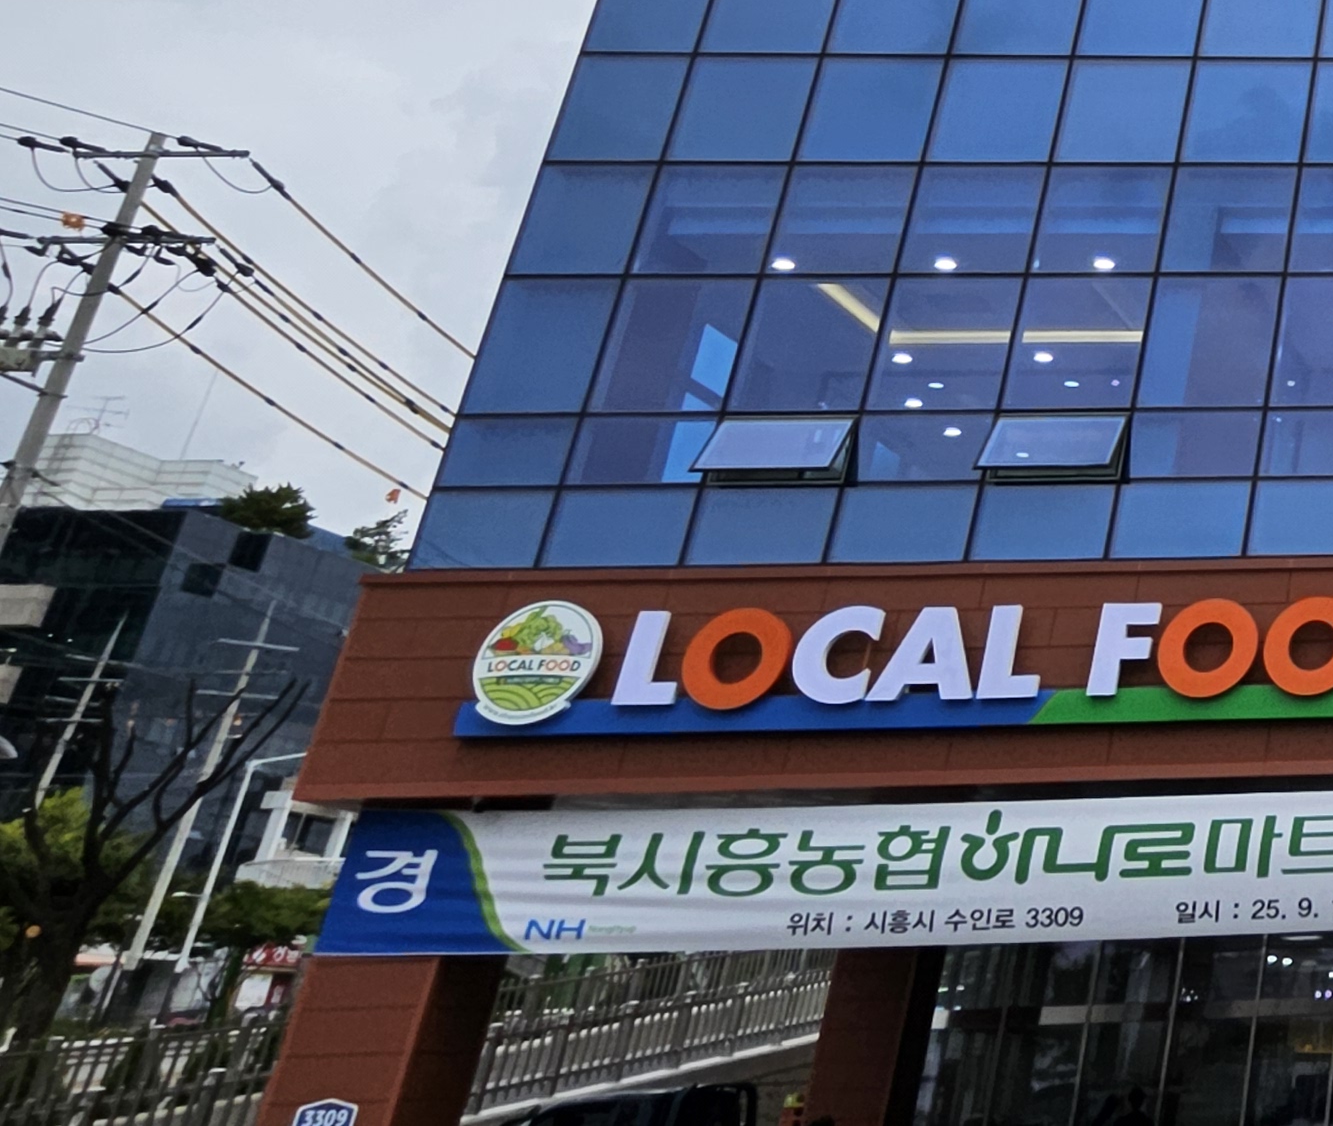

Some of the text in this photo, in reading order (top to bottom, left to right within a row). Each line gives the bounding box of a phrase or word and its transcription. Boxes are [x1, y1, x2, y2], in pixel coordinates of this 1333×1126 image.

[487, 659, 581, 673] LOCAL FOOD
[611, 605, 1040, 711] LOCAL
[356, 849, 438, 914] 경
[786, 911, 834, 936] 위치
[864, 909, 936, 934] 시흥시
[944, 908, 1016, 931] 수인로
[1025, 906, 1084, 928] 3309
[1175, 899, 1221, 923] 일시
[523, 918, 586, 940] NH
[301, 1108, 349, 1126] 3309
